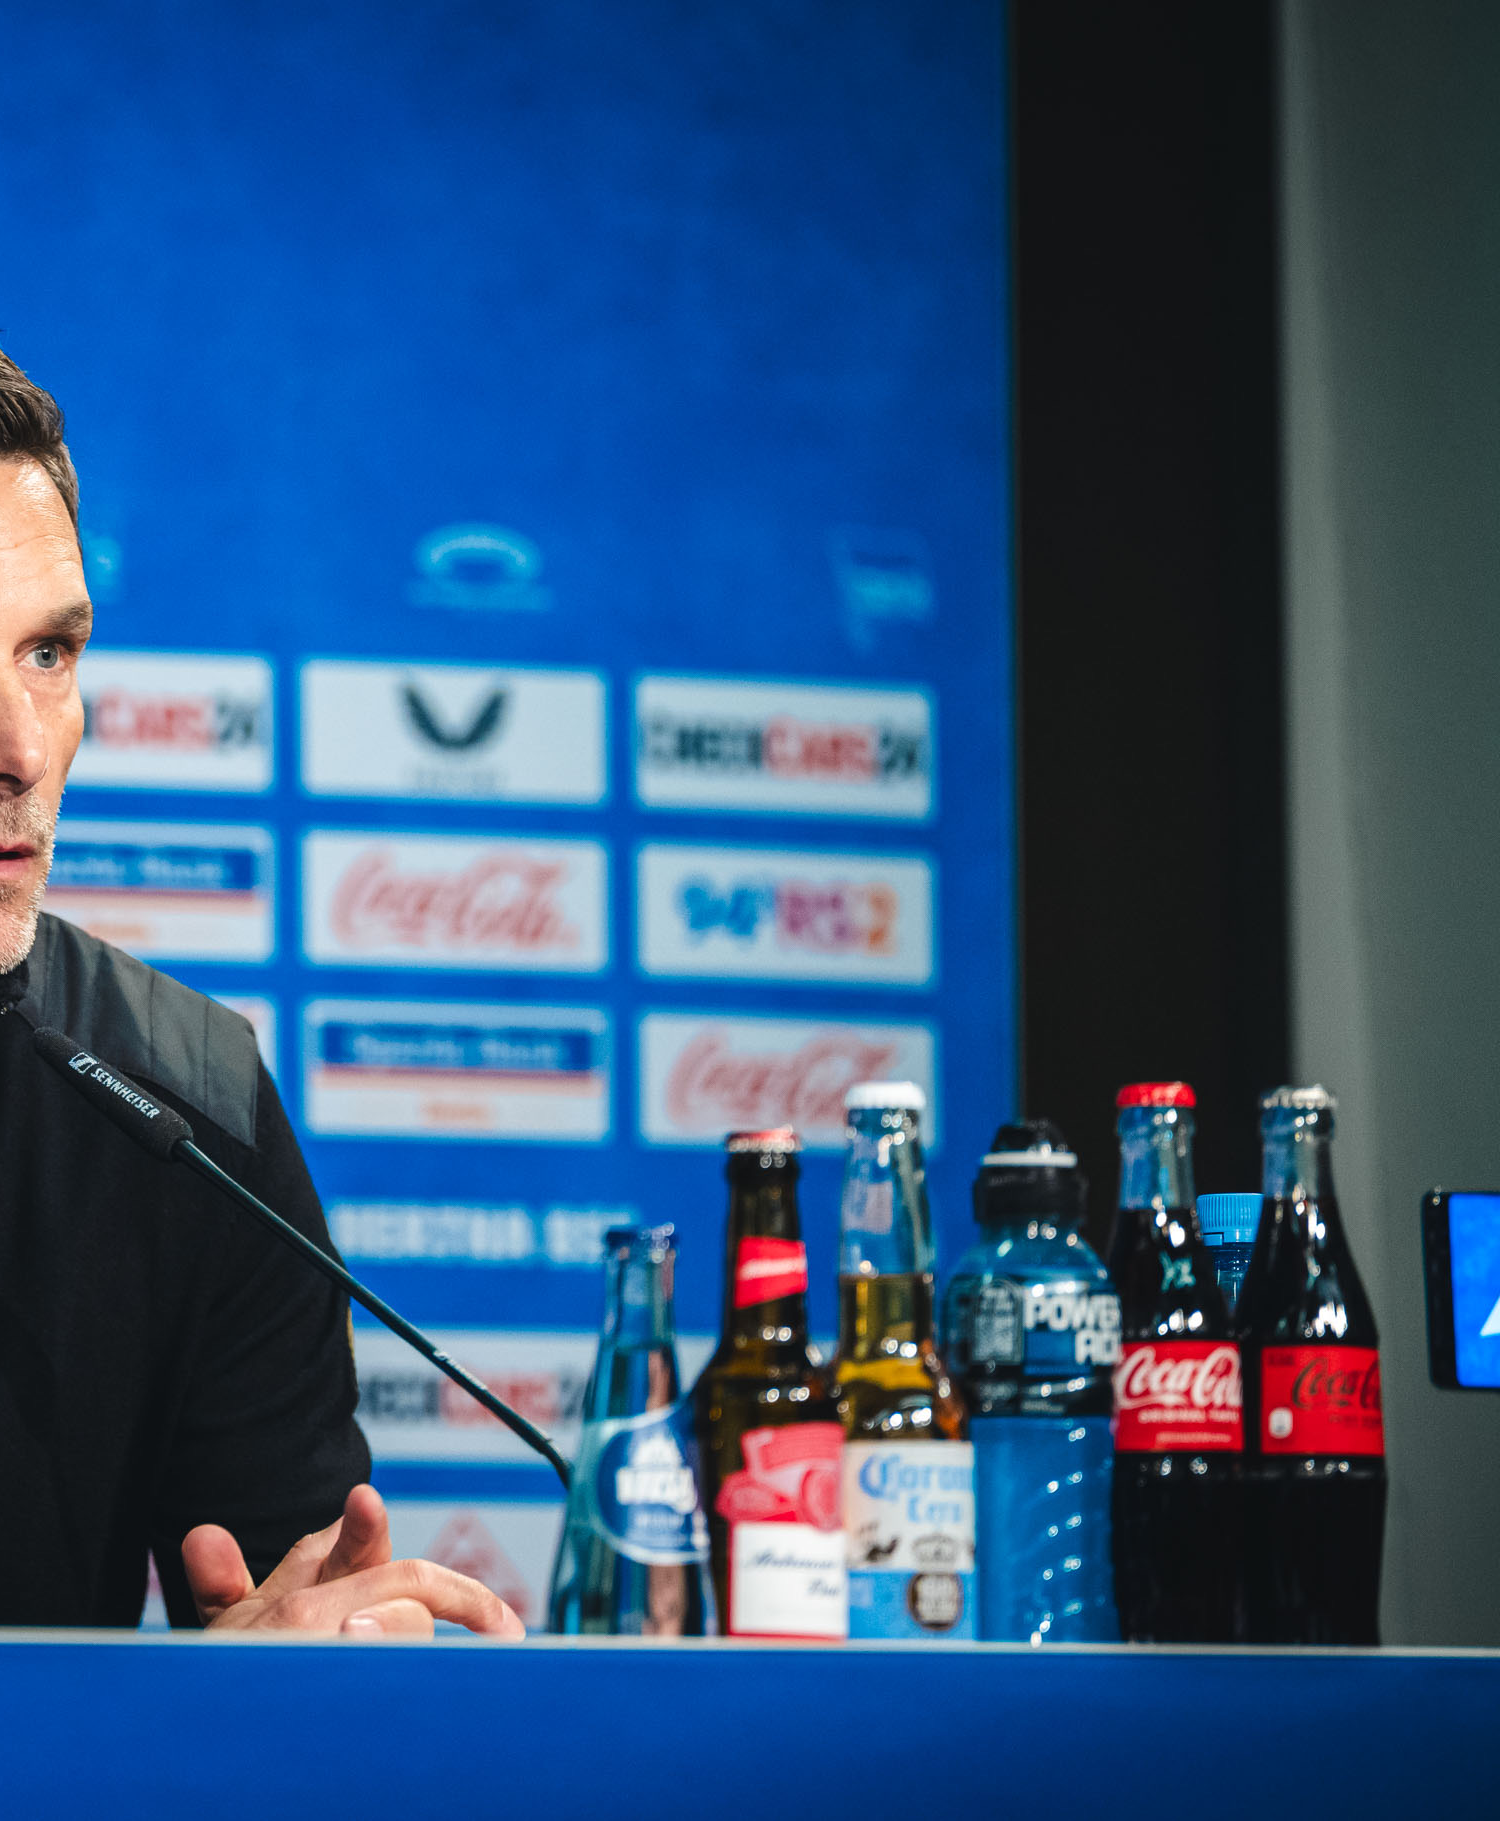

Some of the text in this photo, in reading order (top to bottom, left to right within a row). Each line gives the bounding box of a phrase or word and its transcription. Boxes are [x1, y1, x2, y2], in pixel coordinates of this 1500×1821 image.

[90, 1067, 161, 1120] SENNHEISER
[1023, 1292, 1121, 1331] POWE
[1074, 1330, 1122, 1366] AD
[859, 1454, 973, 1501] Coron
